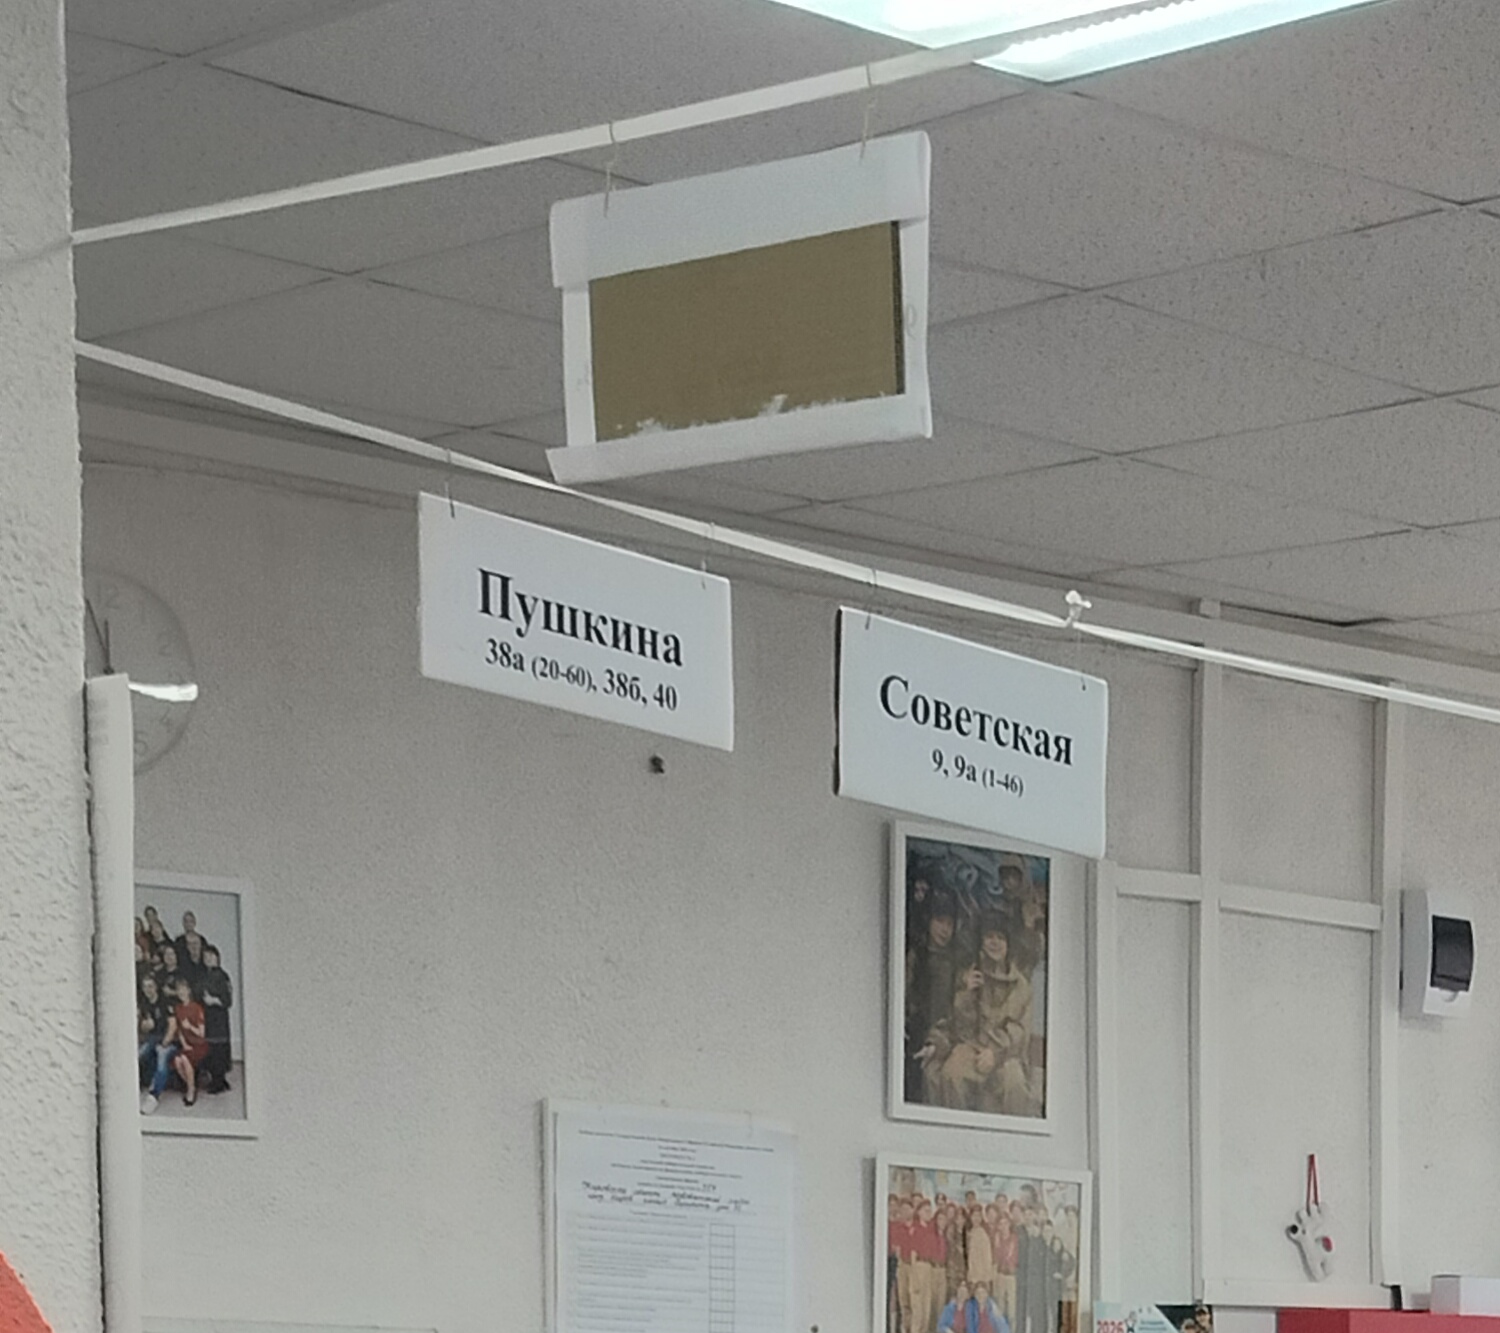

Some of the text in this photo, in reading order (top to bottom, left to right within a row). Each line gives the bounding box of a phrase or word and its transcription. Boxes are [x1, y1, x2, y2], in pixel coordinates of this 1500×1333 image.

[477, 567, 684, 667] Пушкина
[485, 637, 678, 712] 38а (20-60), 38б, 40
[879, 674, 1073, 767] Советская
[931, 748, 1024, 798] 9, 9а (1-46)
